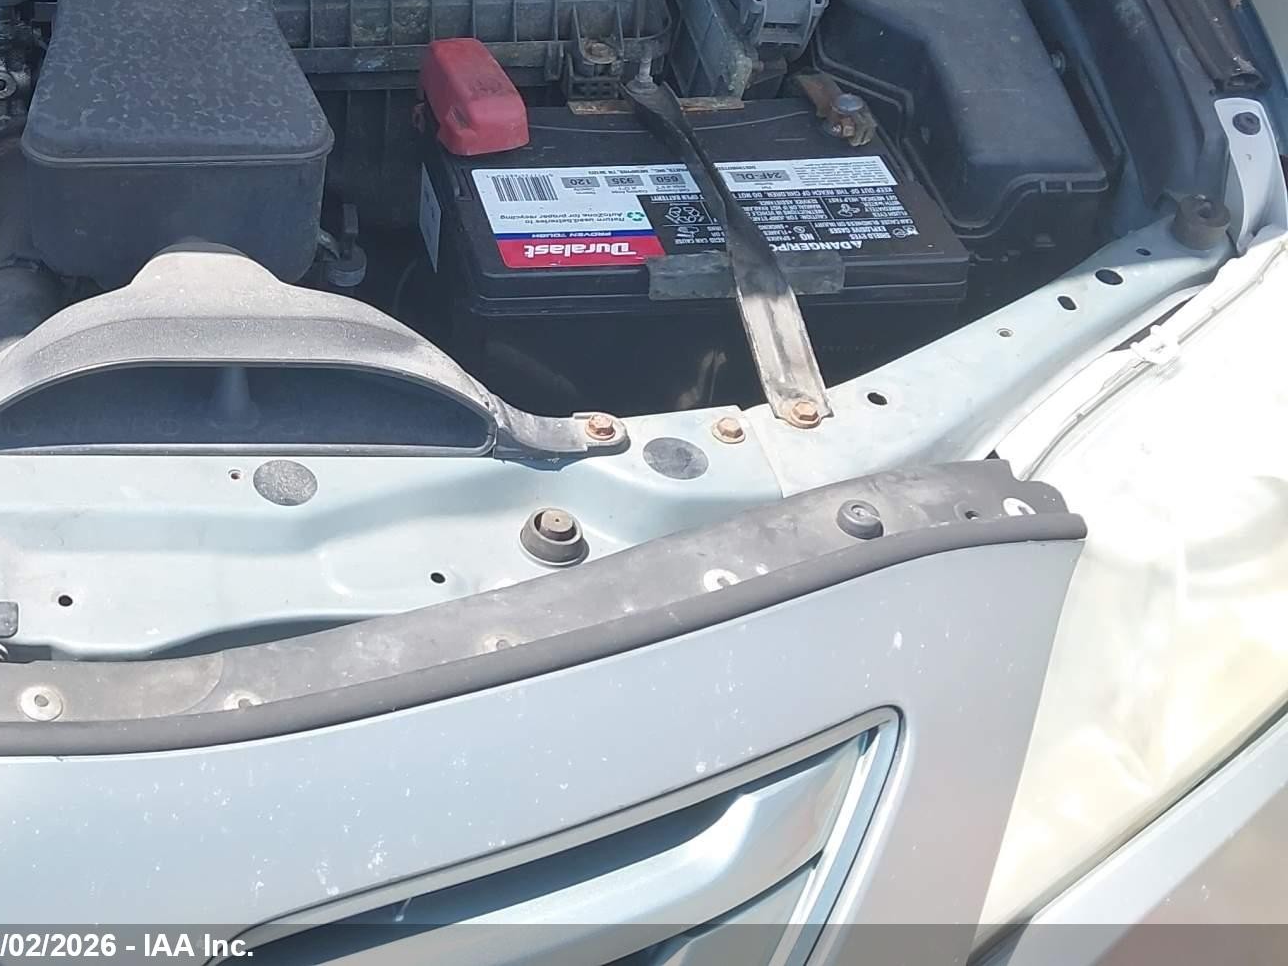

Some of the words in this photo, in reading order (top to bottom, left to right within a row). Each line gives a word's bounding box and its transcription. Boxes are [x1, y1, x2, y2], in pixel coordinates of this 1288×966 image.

[570, 178, 592, 186] 120
[611, 177, 634, 185] 935
[656, 175, 679, 183] 650
[799, 233, 815, 241] NO
[523, 242, 637, 259] Duralast
